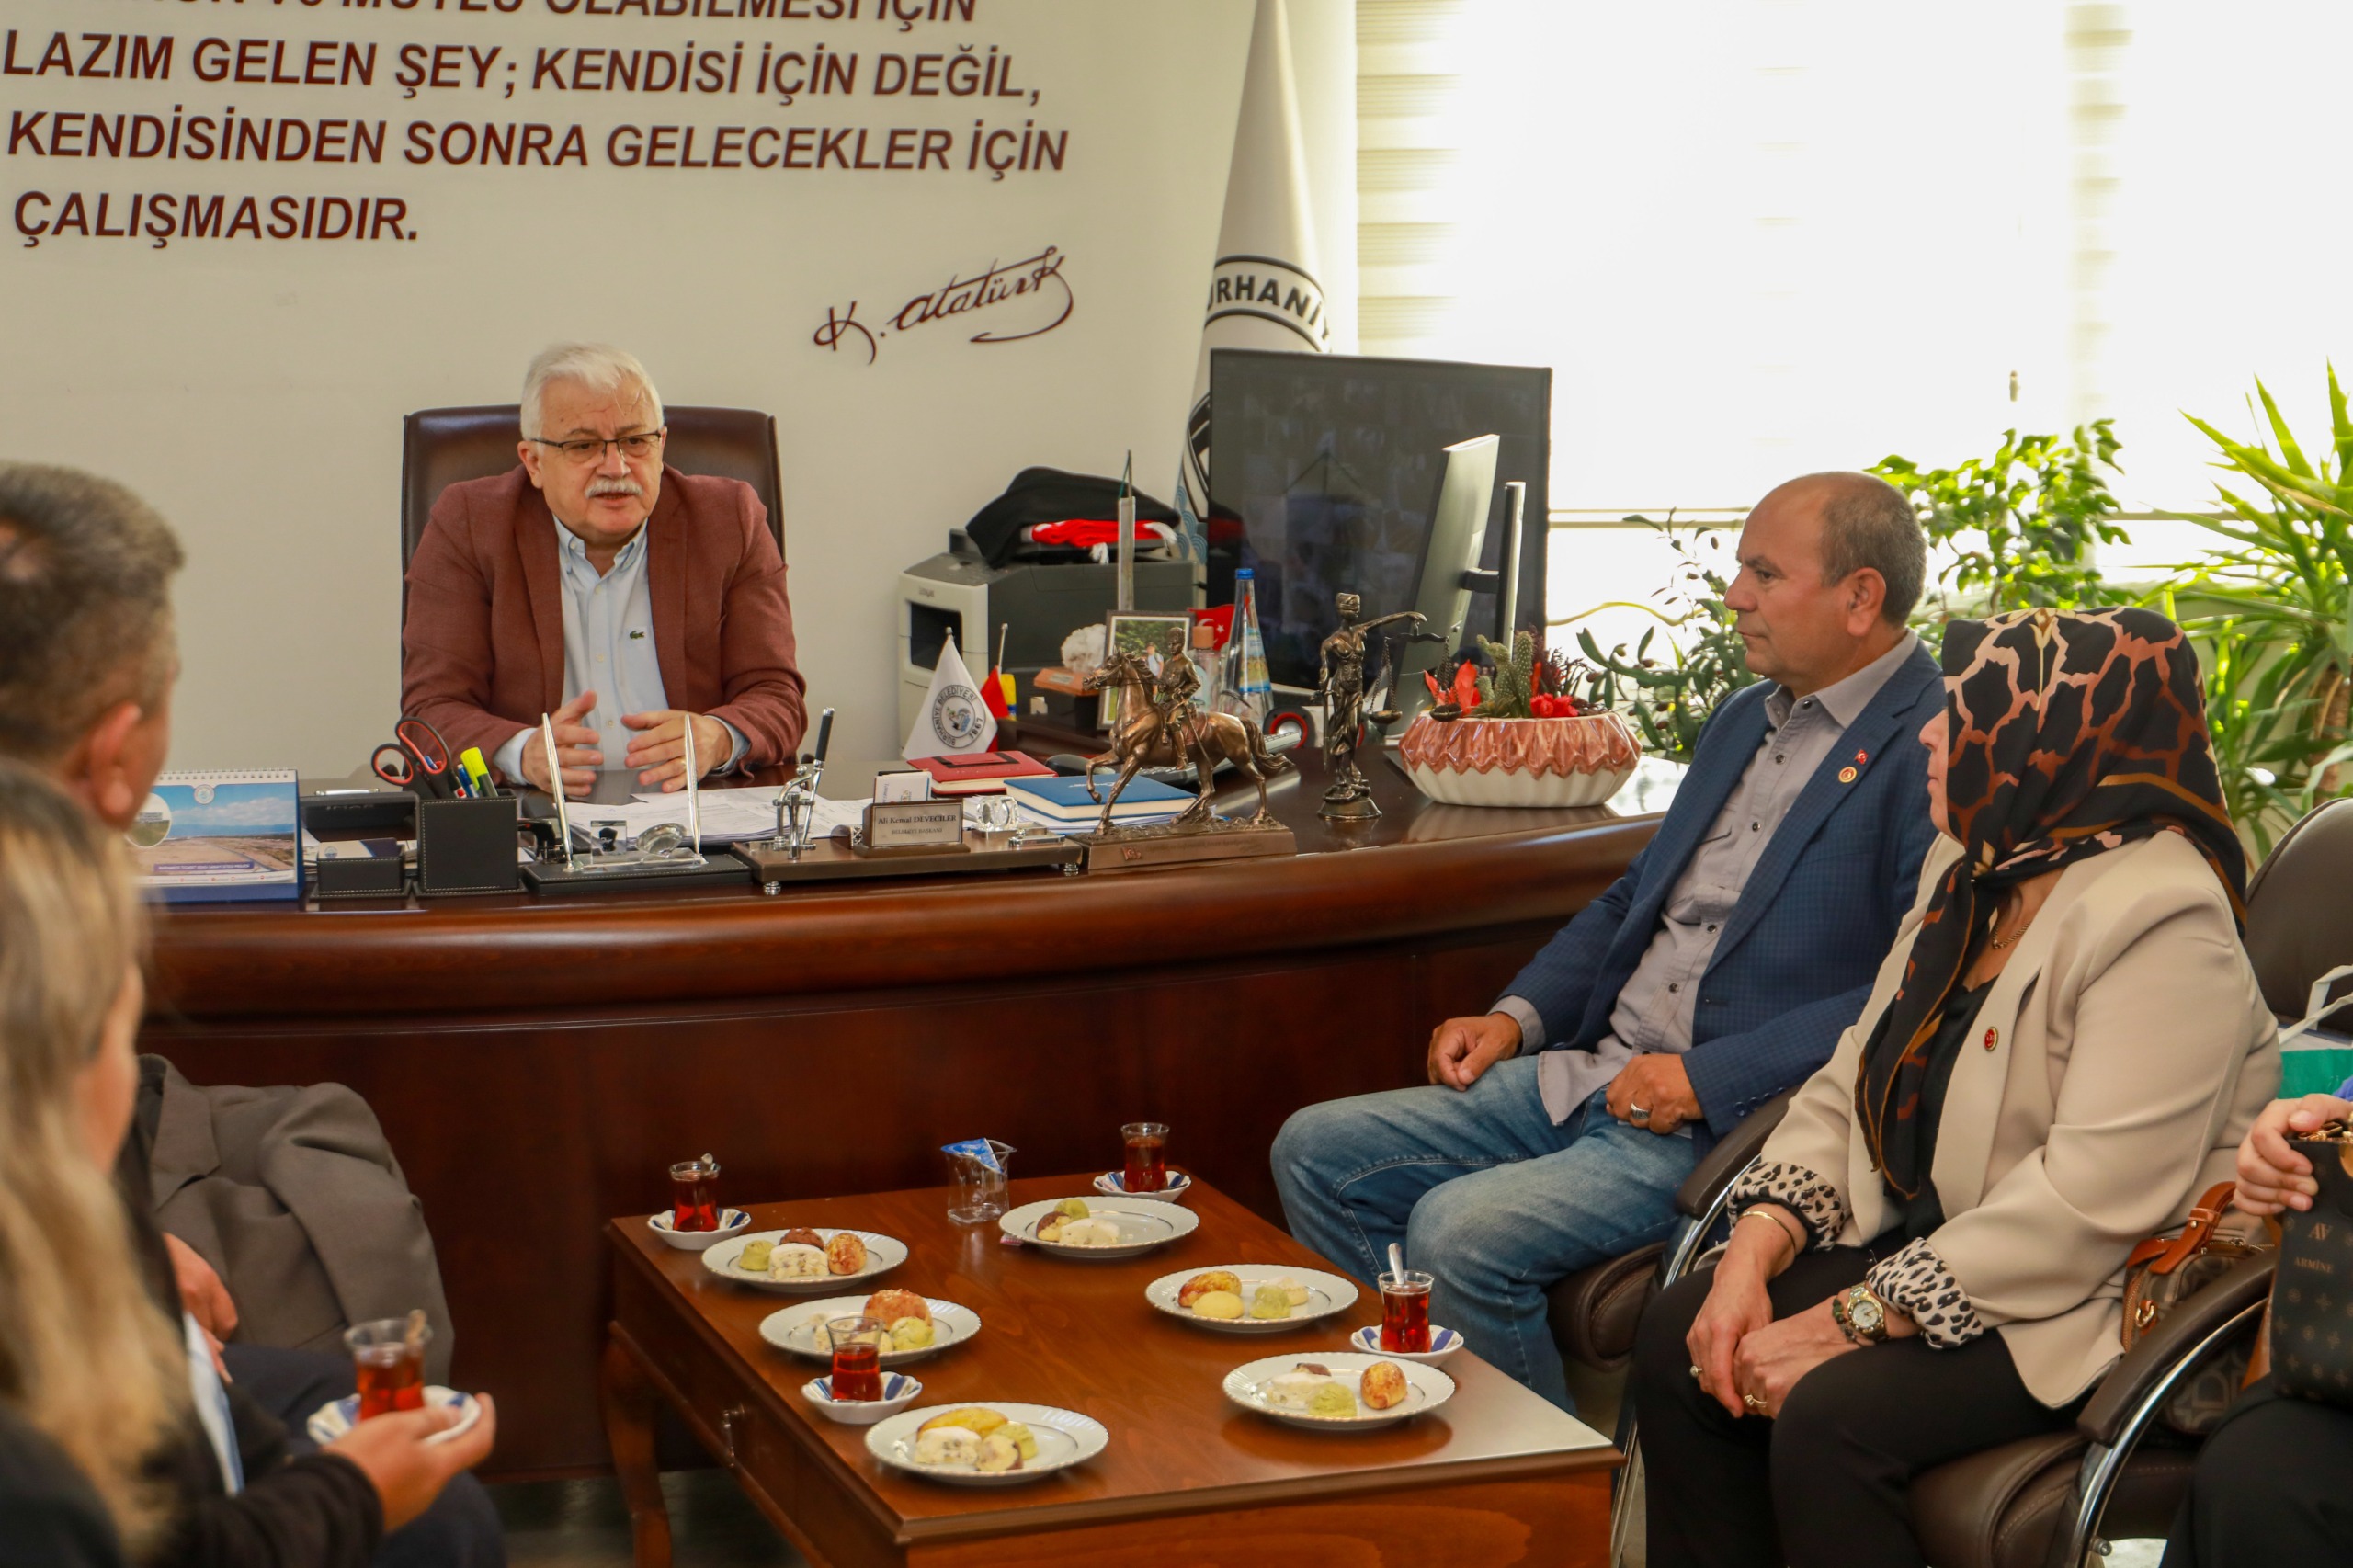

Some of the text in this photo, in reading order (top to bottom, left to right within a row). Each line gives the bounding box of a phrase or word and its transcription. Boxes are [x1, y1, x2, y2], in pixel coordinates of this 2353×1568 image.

[3, 29, 1040, 107] LAZIM GELEN ŞEY; KENDİSİ İÇİN DEĞİL,
[7, 104, 1069, 182] KENDİSİNDEN SONRA GELECEKLER İÇİN
[13, 190, 418, 249] ÇALIŞMASIDIR.
[890, 816, 912, 824] Kemal
